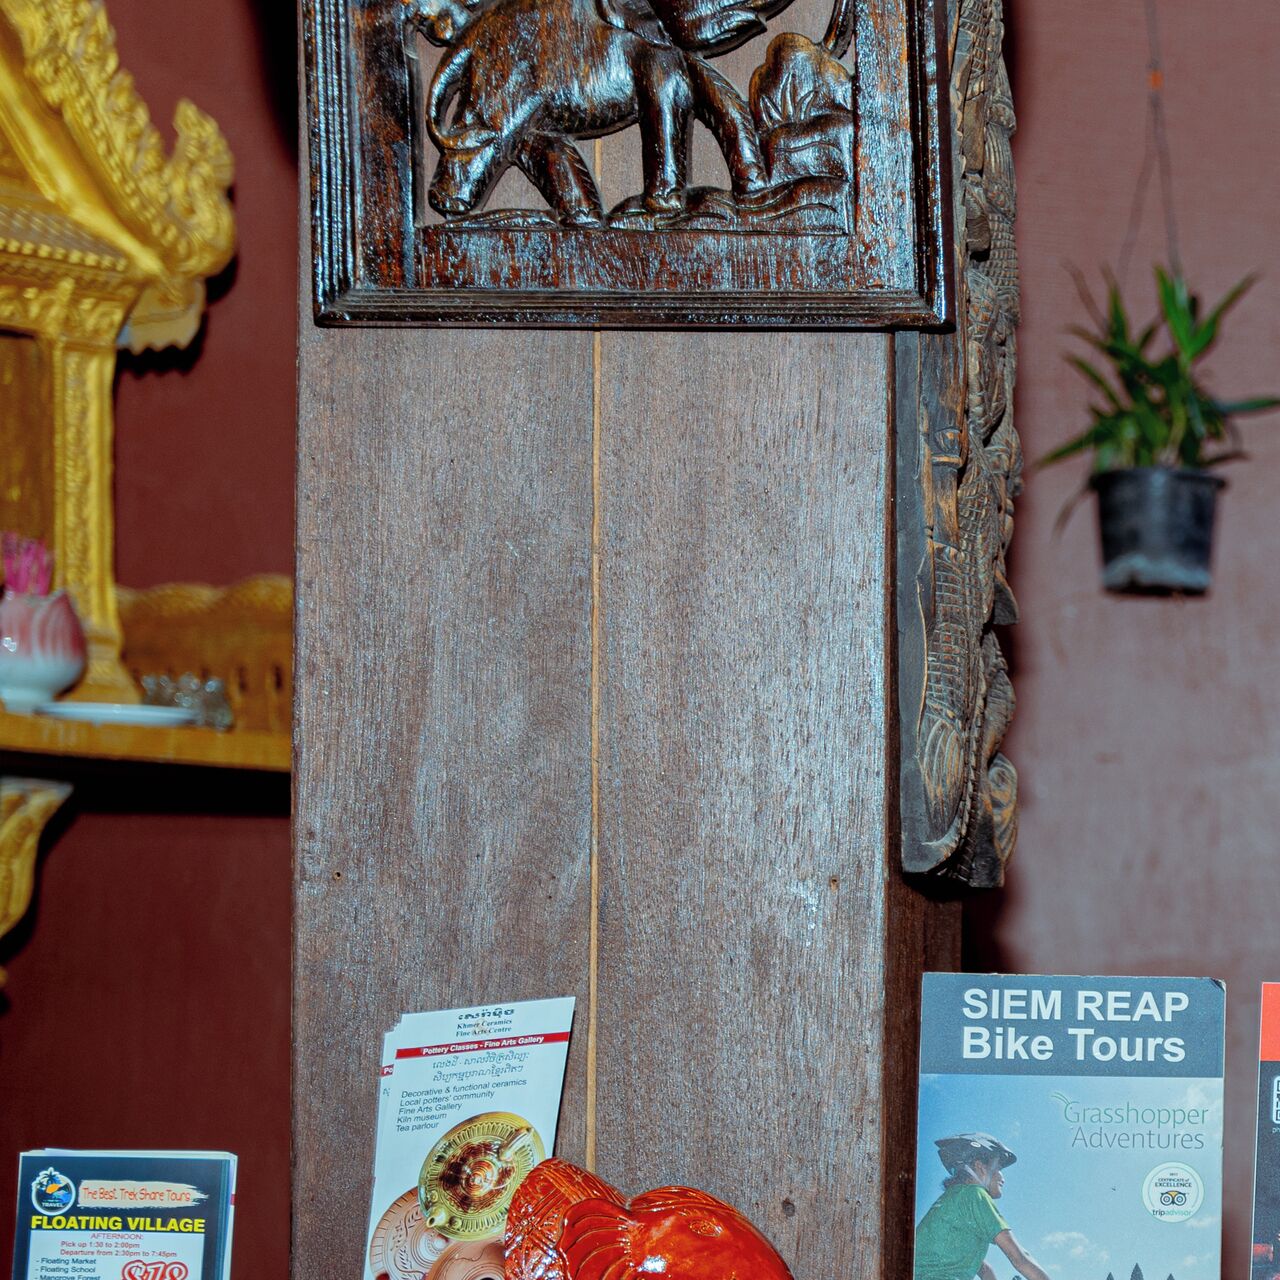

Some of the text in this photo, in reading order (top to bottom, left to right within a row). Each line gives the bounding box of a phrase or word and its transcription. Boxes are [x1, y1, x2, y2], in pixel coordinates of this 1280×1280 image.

[962, 988, 1190, 1023] SIEM REAP
[422, 1035, 544, 1056] Pottery Classes Fine Arts Gallery
[962, 1026, 1187, 1063] Bike Tours
[401, 1078, 527, 1099] Decorative & functional ceramics
[398, 1101, 463, 1115] Fine Arts Gallery
[400, 1097, 422, 1108] Local
[452, 1090, 495, 1102] community
[396, 1112, 448, 1125] Kiln museum
[1064, 1100, 1209, 1129] Grasshopper
[395, 1121, 439, 1133] Tea parlour
[1071, 1126, 1205, 1150] Adventures
[31, 1215, 206, 1233] FLOATING VILLAGE
[40, 1257, 70, 1265] Floating
[40, 1266, 69, 1274] Floating
